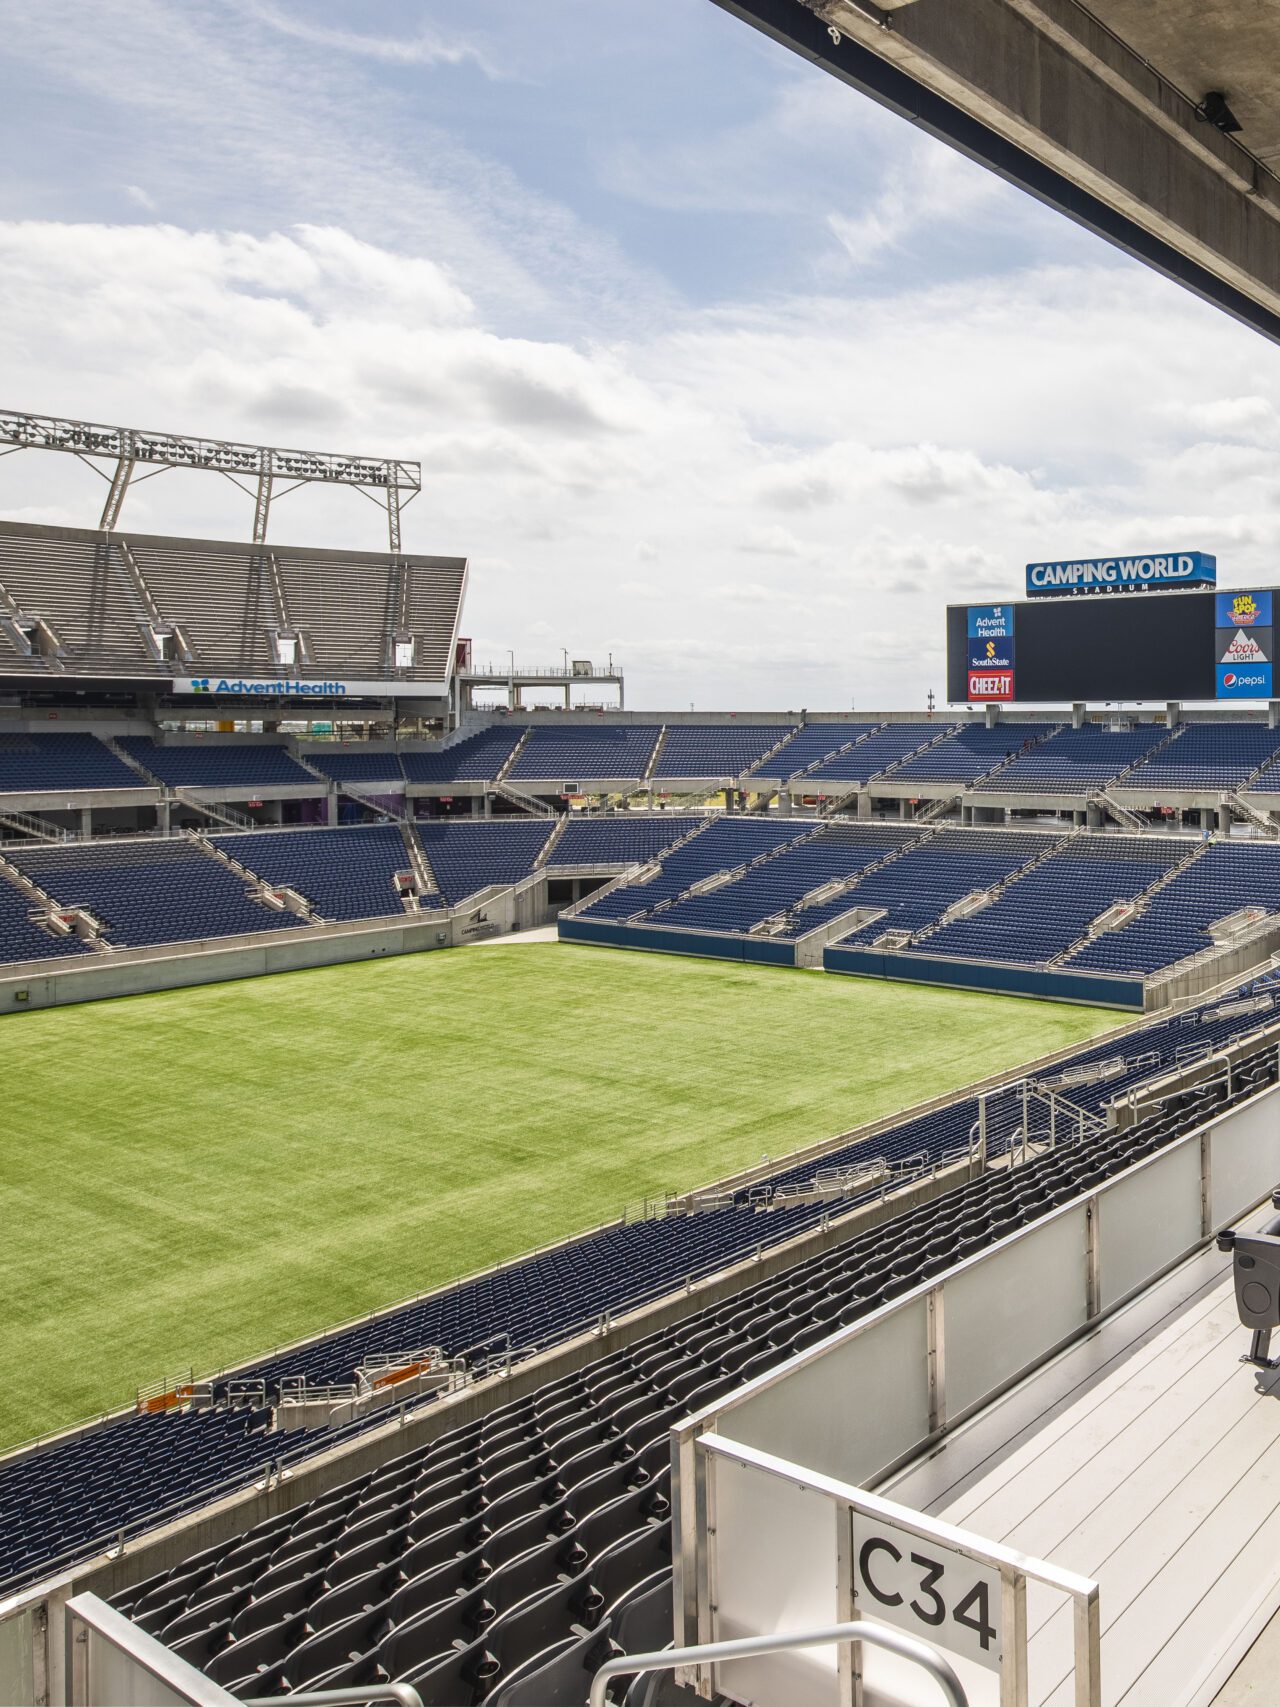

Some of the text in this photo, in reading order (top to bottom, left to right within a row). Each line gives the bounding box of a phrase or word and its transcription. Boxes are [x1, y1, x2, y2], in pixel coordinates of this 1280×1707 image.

[1031, 556, 1194, 586] CAMPING WORLD
[1072, 583, 1149, 595] STADIUM
[1233, 595, 1252, 607] FUN
[1234, 603, 1257, 614] SPOT
[976, 617, 1006, 627] Advent
[978, 627, 1006, 637] Health
[1226, 639, 1260, 654] Coors
[972, 657, 1010, 667] SouthState
[970, 676, 1011, 695] CHEEZ-IT
[1238, 675, 1265, 686] pepsi
[215, 679, 346, 695] AdventHealth
[859, 1537, 996, 1651] C34
